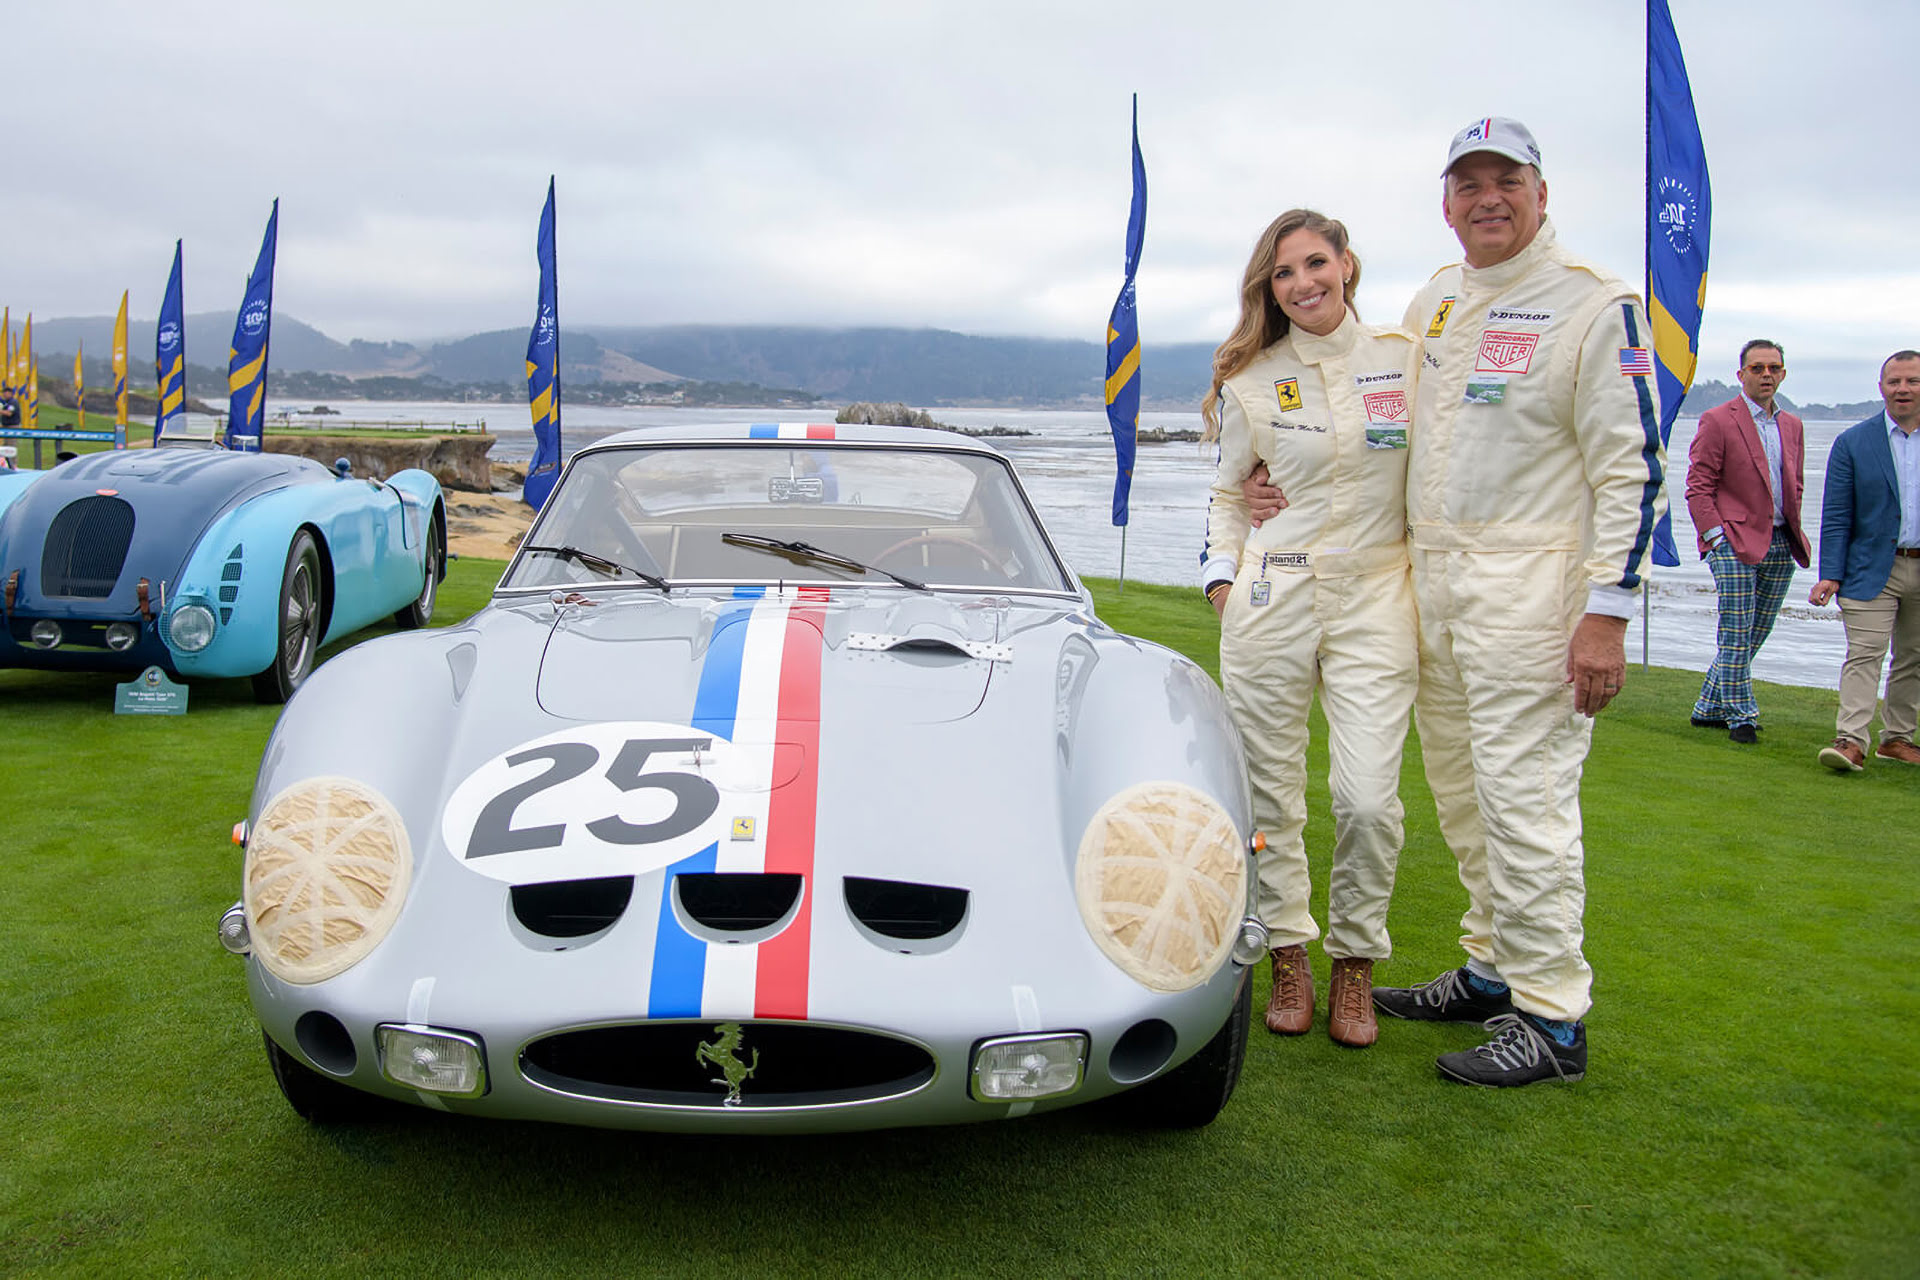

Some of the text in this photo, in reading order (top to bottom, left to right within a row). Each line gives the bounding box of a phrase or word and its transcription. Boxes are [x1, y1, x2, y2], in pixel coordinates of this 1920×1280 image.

[1497, 311, 1551, 321] DUNLOP
[1485, 334, 1536, 343] CHRONOGRAPH
[1484, 343, 1528, 365] HEUER
[1365, 373, 1403, 383] DUNLOP
[1371, 401, 1403, 417] HEUER
[465, 738, 720, 860] 25
